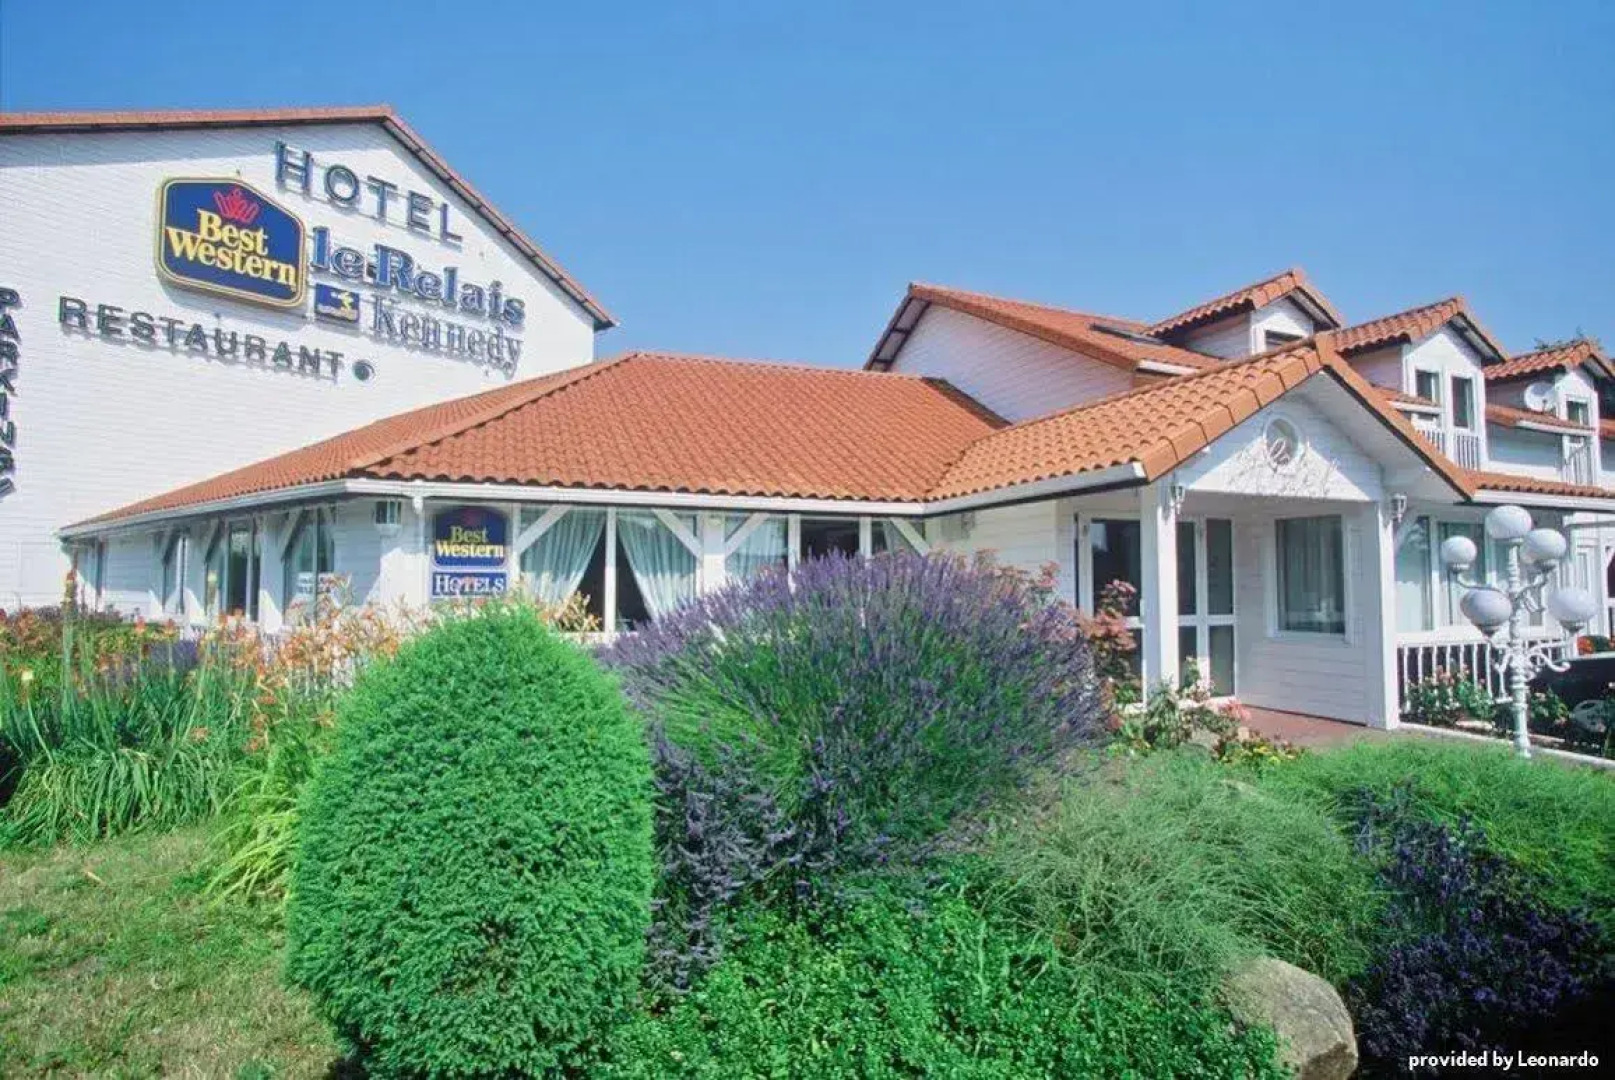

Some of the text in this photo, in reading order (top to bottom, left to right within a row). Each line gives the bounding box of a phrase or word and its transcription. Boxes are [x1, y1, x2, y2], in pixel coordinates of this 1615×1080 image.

[275, 140, 463, 242] HOTEL
[165, 226, 298, 286] Western
[197, 208, 269, 255] Best
[374, 244, 525, 325] Relais
[59, 296, 344, 377] RESTAURANT
[373, 294, 524, 378] Kennedy
[436, 540, 504, 557] Western
[450, 525, 488, 543] Best
[435, 574, 504, 594] HOTELS
